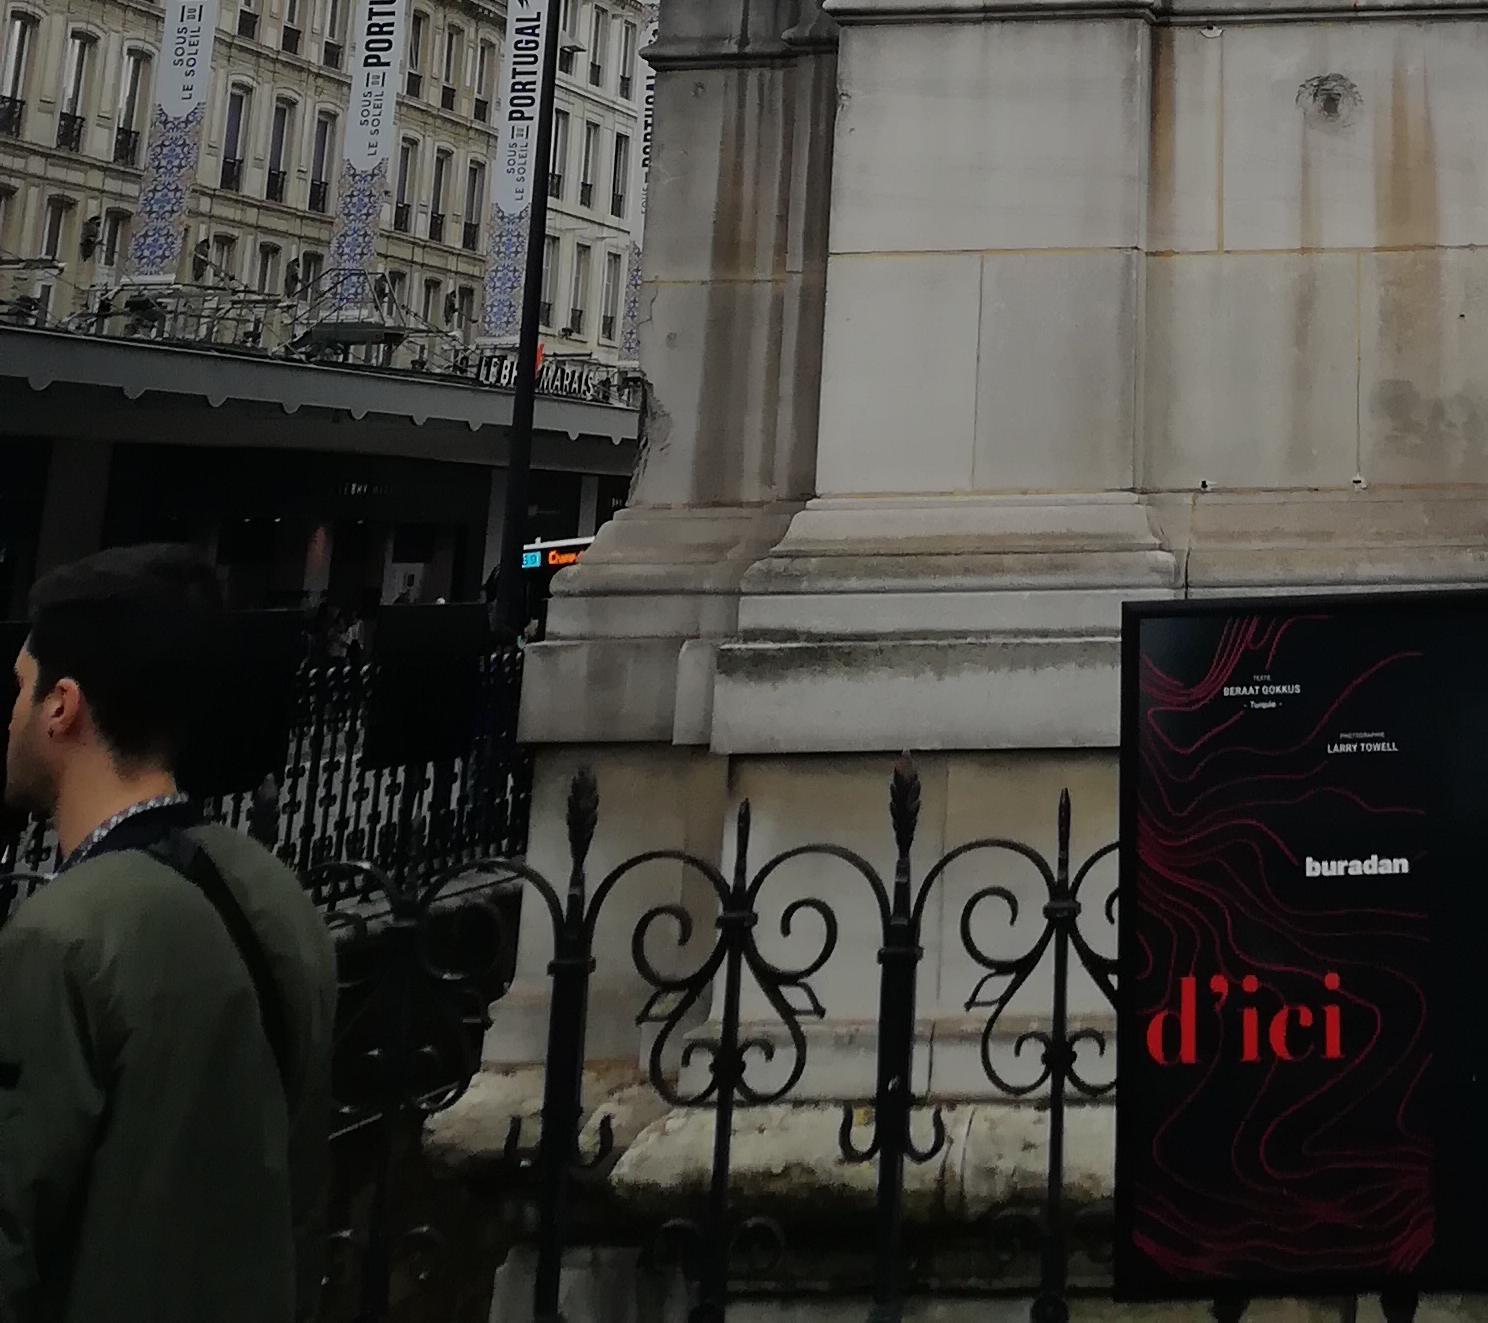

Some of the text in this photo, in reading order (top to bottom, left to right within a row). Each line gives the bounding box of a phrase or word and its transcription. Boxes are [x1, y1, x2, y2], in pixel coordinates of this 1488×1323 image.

[173, 26, 187, 66] SOUS
[181, 26, 201, 100] LE SOLEIL
[508, 12, 541, 121] PORTUGAL
[360, 91, 372, 126] SOUS
[367, 91, 384, 156] LE SOLEIL
[506, 142, 517, 174] SOUS
[515, 142, 528, 201] LE SOLEIL
[540, 364, 594, 397] MARAIS
[1327, 741, 1399, 754] LARRY TOWELL
[1305, 854, 1410, 877] buradan
[1146, 972, 1345, 1064] d'ici
